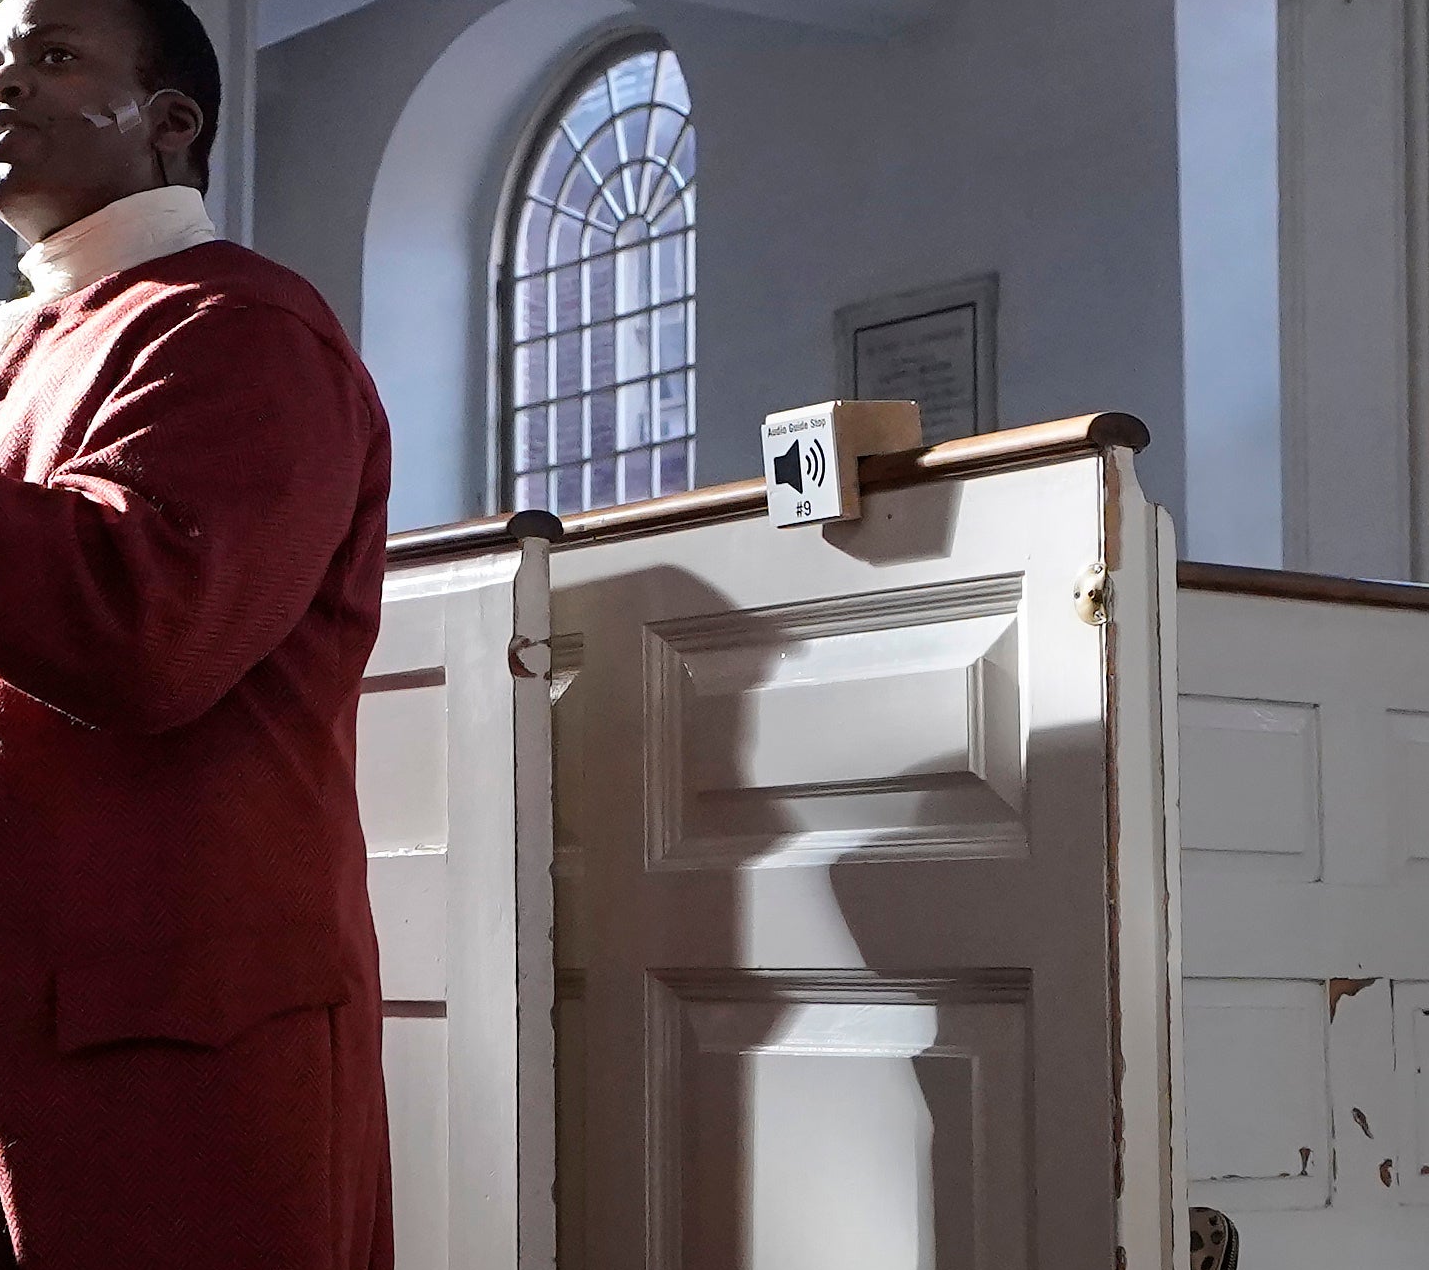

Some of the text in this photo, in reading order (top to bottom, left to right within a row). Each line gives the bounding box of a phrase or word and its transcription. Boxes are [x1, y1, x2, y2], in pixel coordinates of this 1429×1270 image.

[768, 418, 826, 438] Audio Guide Stop
[796, 500, 812, 517] #9
